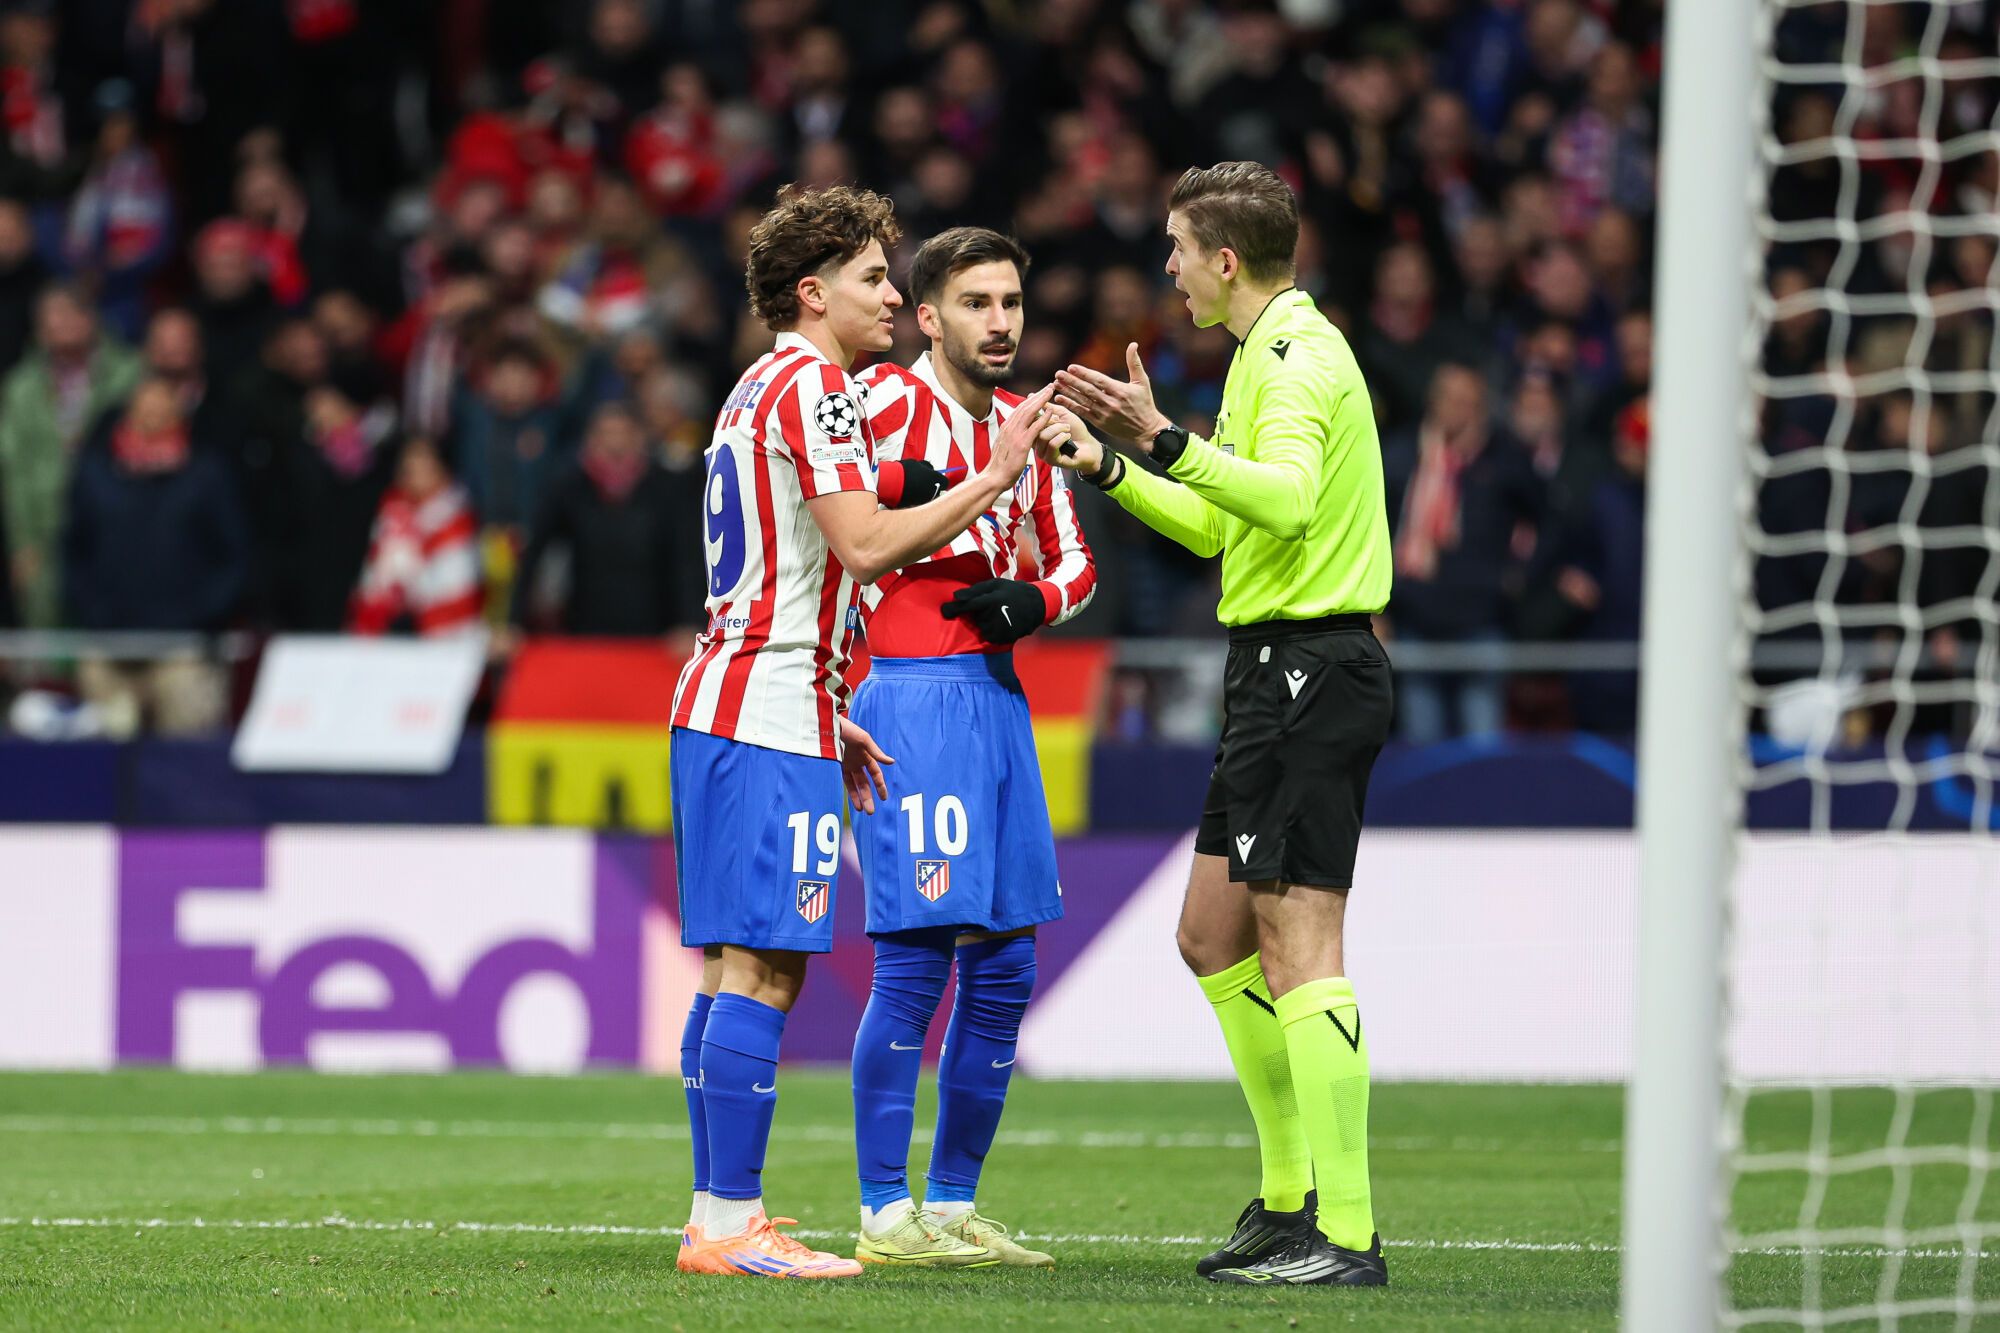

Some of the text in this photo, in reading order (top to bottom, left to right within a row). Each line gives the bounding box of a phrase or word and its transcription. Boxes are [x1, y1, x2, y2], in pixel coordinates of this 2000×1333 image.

[703, 443, 746, 598] 9
[787, 811, 840, 876] 19
[901, 793, 968, 856] 10
[116, 826, 641, 1068] Fed
